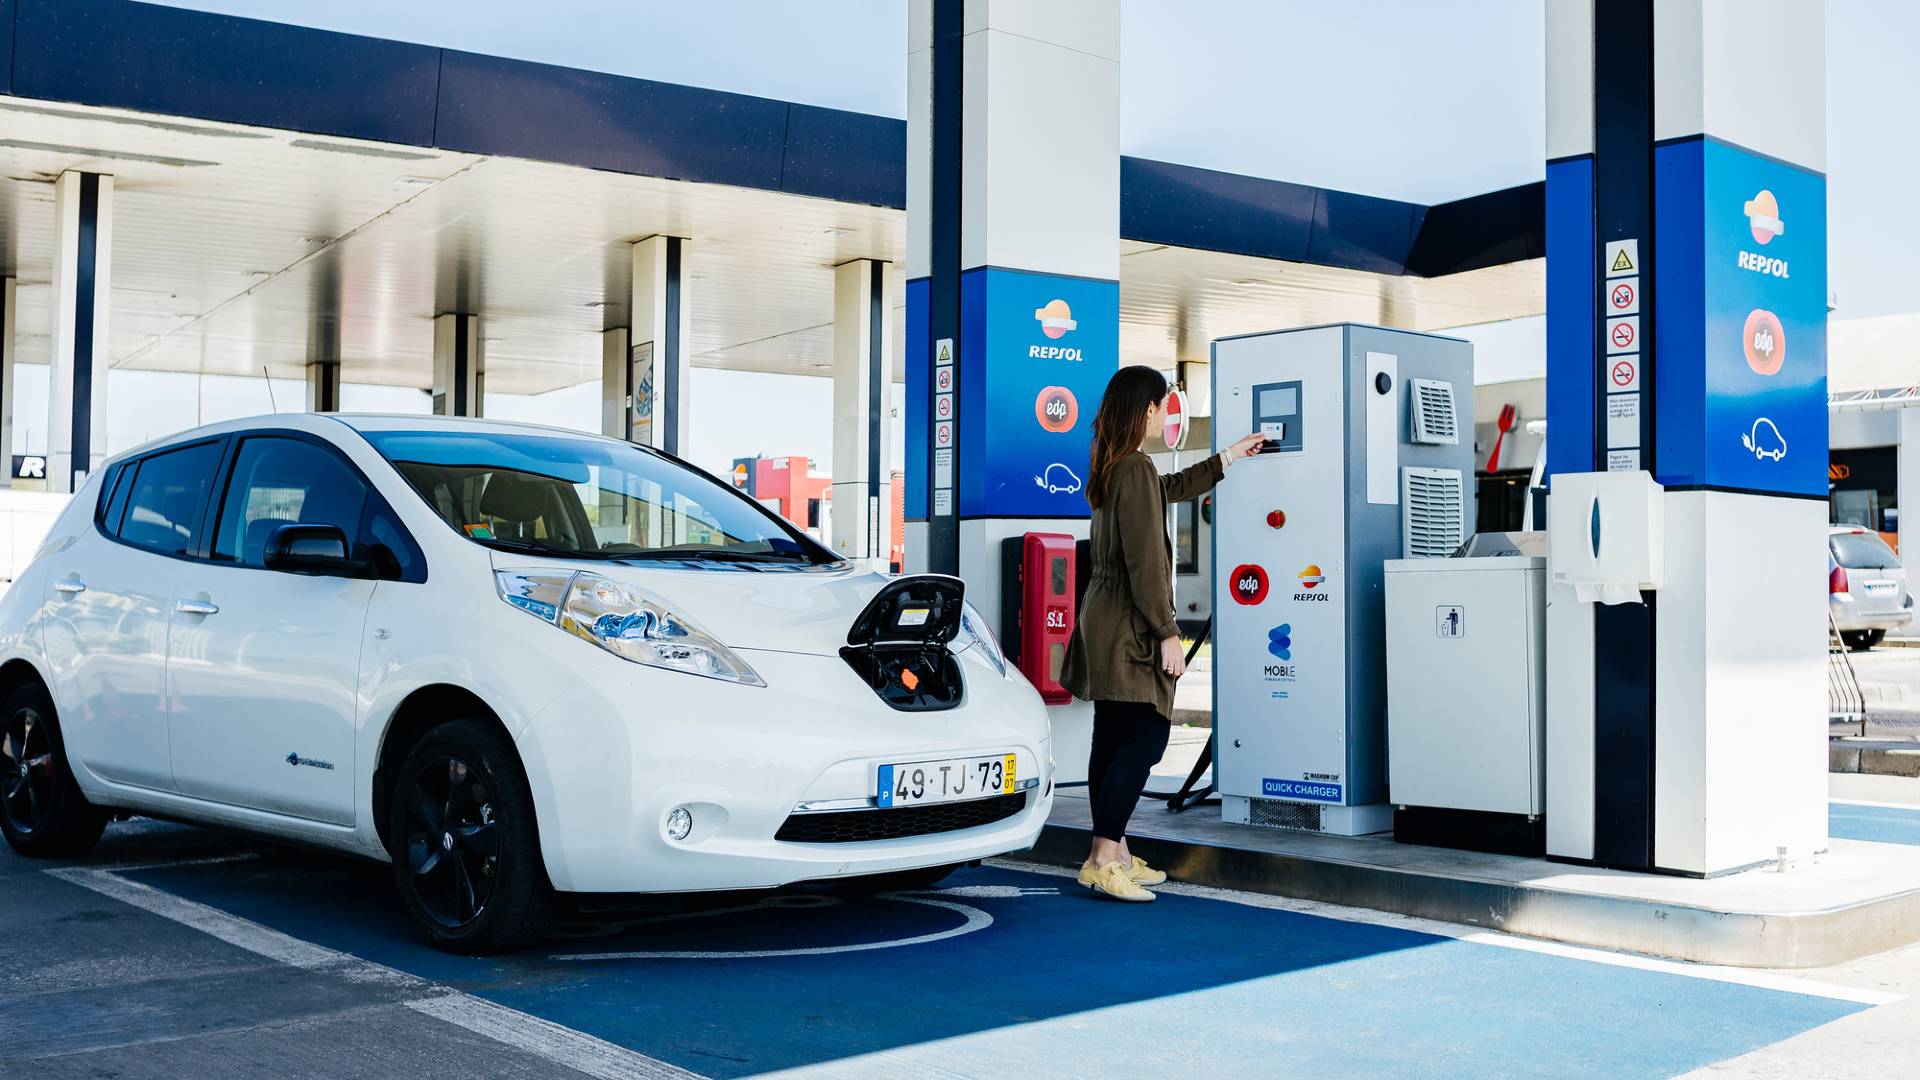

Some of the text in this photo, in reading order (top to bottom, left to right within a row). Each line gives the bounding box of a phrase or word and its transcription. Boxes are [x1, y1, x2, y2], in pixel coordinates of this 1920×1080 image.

[1738, 250, 1790, 278] REPSOL
[1754, 328, 1774, 357] edp
[1029, 345, 1083, 361] REPSOL
[1046, 399, 1067, 420] edp
[1239, 575, 1259, 594] edp
[1293, 593, 1329, 602] REPSOL
[1047, 611, 1066, 628] S.I.
[1007, 759, 1015, 770] 17
[1004, 778, 1014, 789] 07
[1265, 782, 1338, 798] QUICK CHARGER
[882, 791, 889, 801] P
